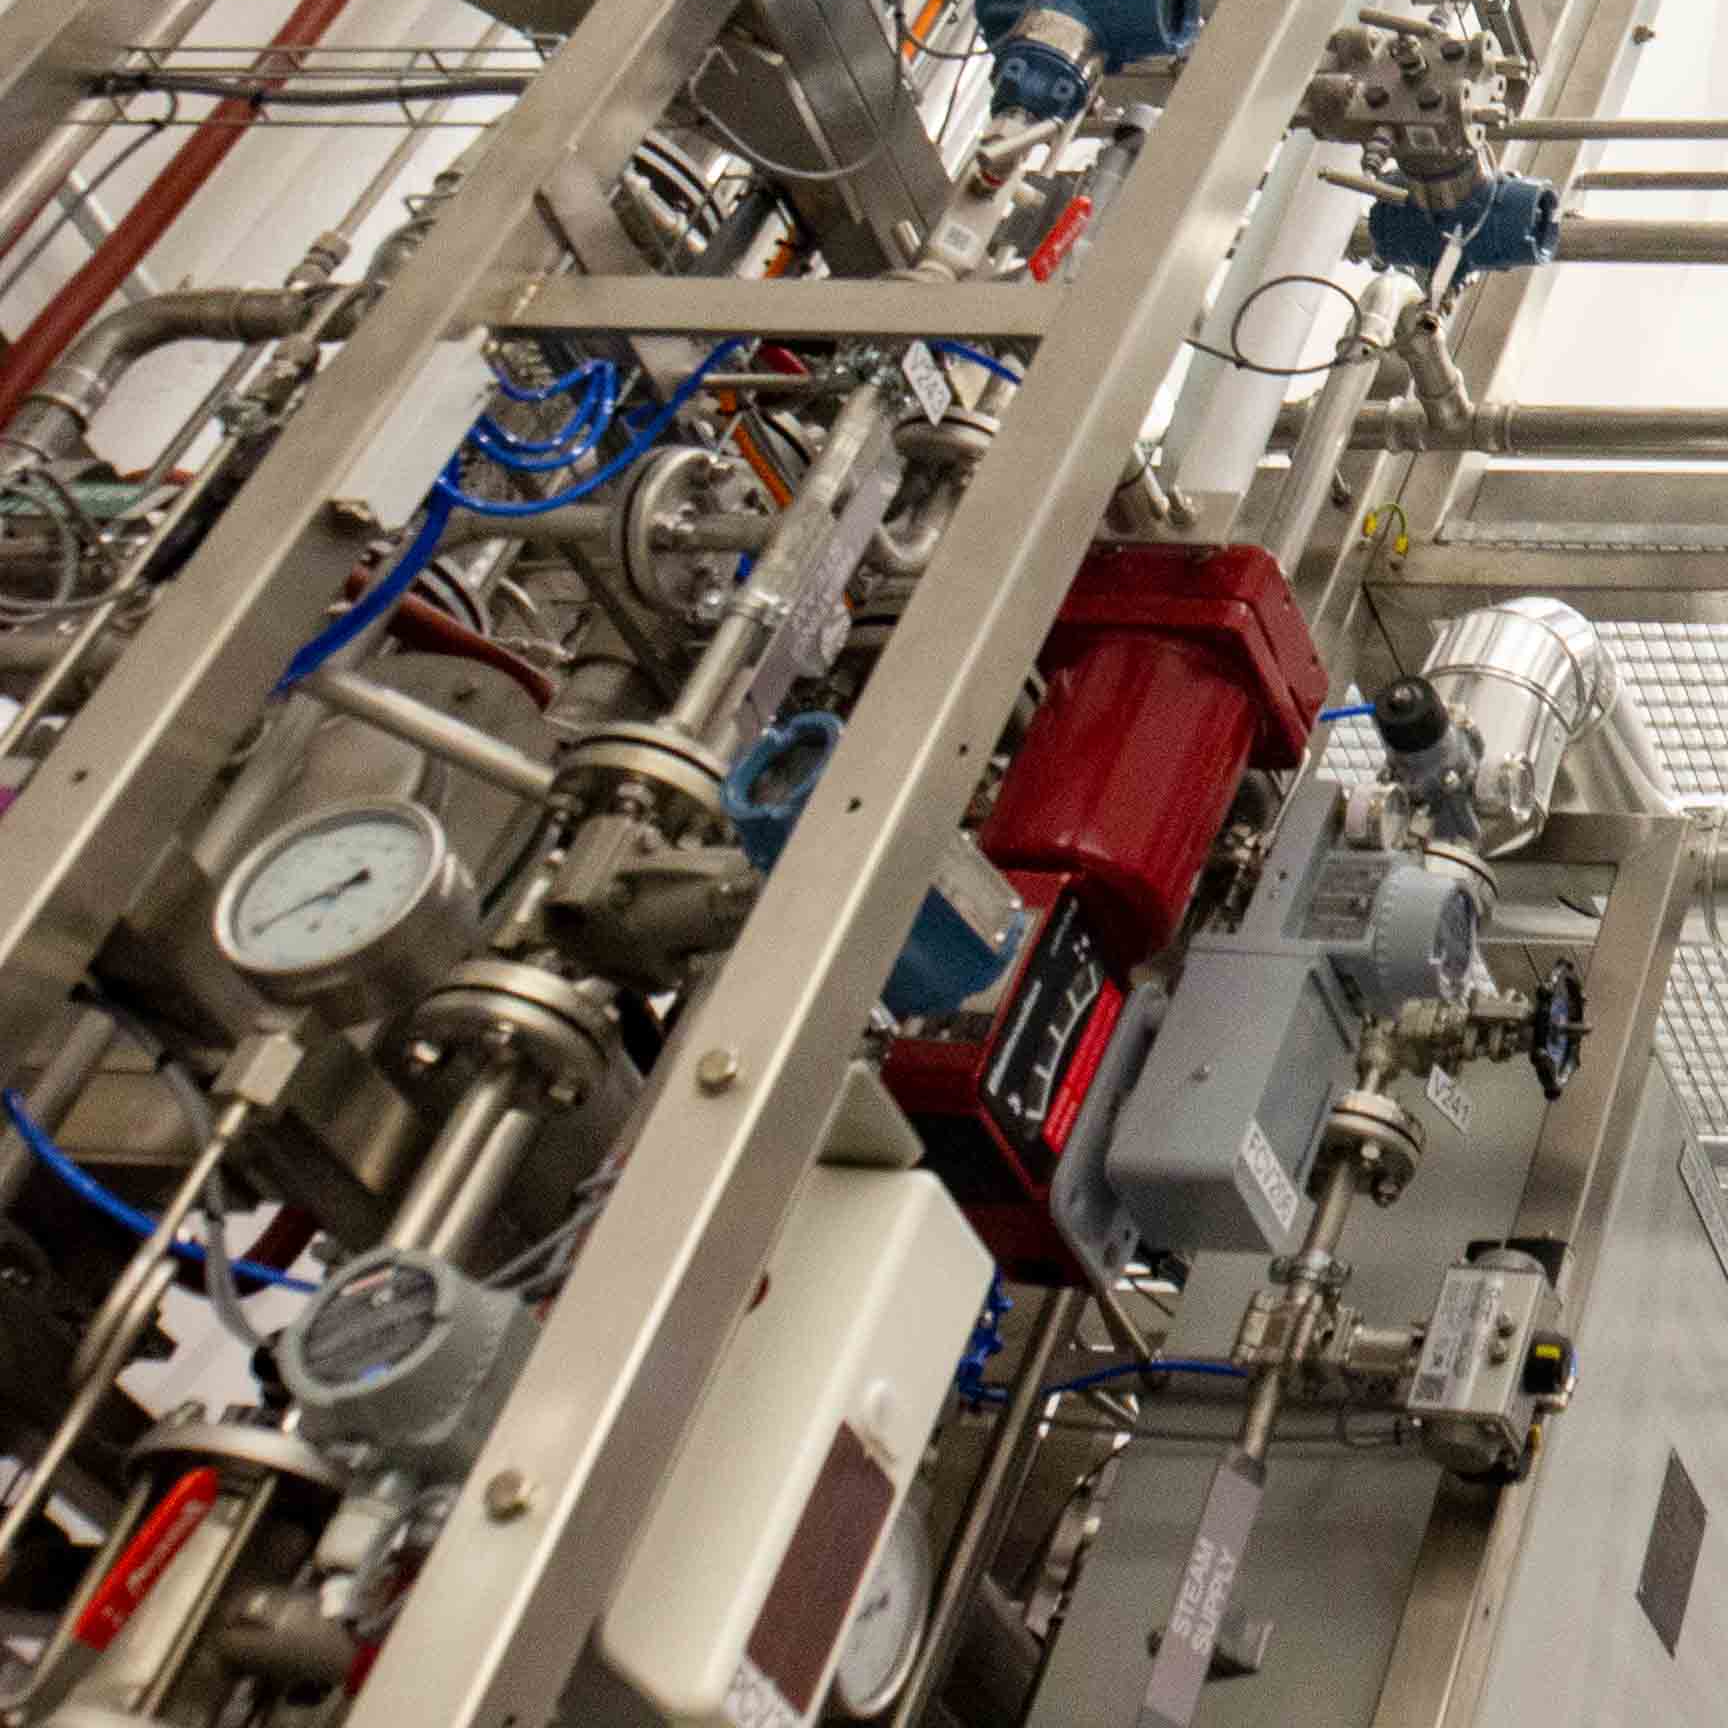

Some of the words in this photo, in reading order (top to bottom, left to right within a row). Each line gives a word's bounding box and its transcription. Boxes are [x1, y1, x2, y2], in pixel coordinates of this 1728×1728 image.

[1433, 1068, 1473, 1127] V241
[1170, 1538, 1216, 1638] STEAM
[1192, 1546, 1237, 1656] SUPPLY
